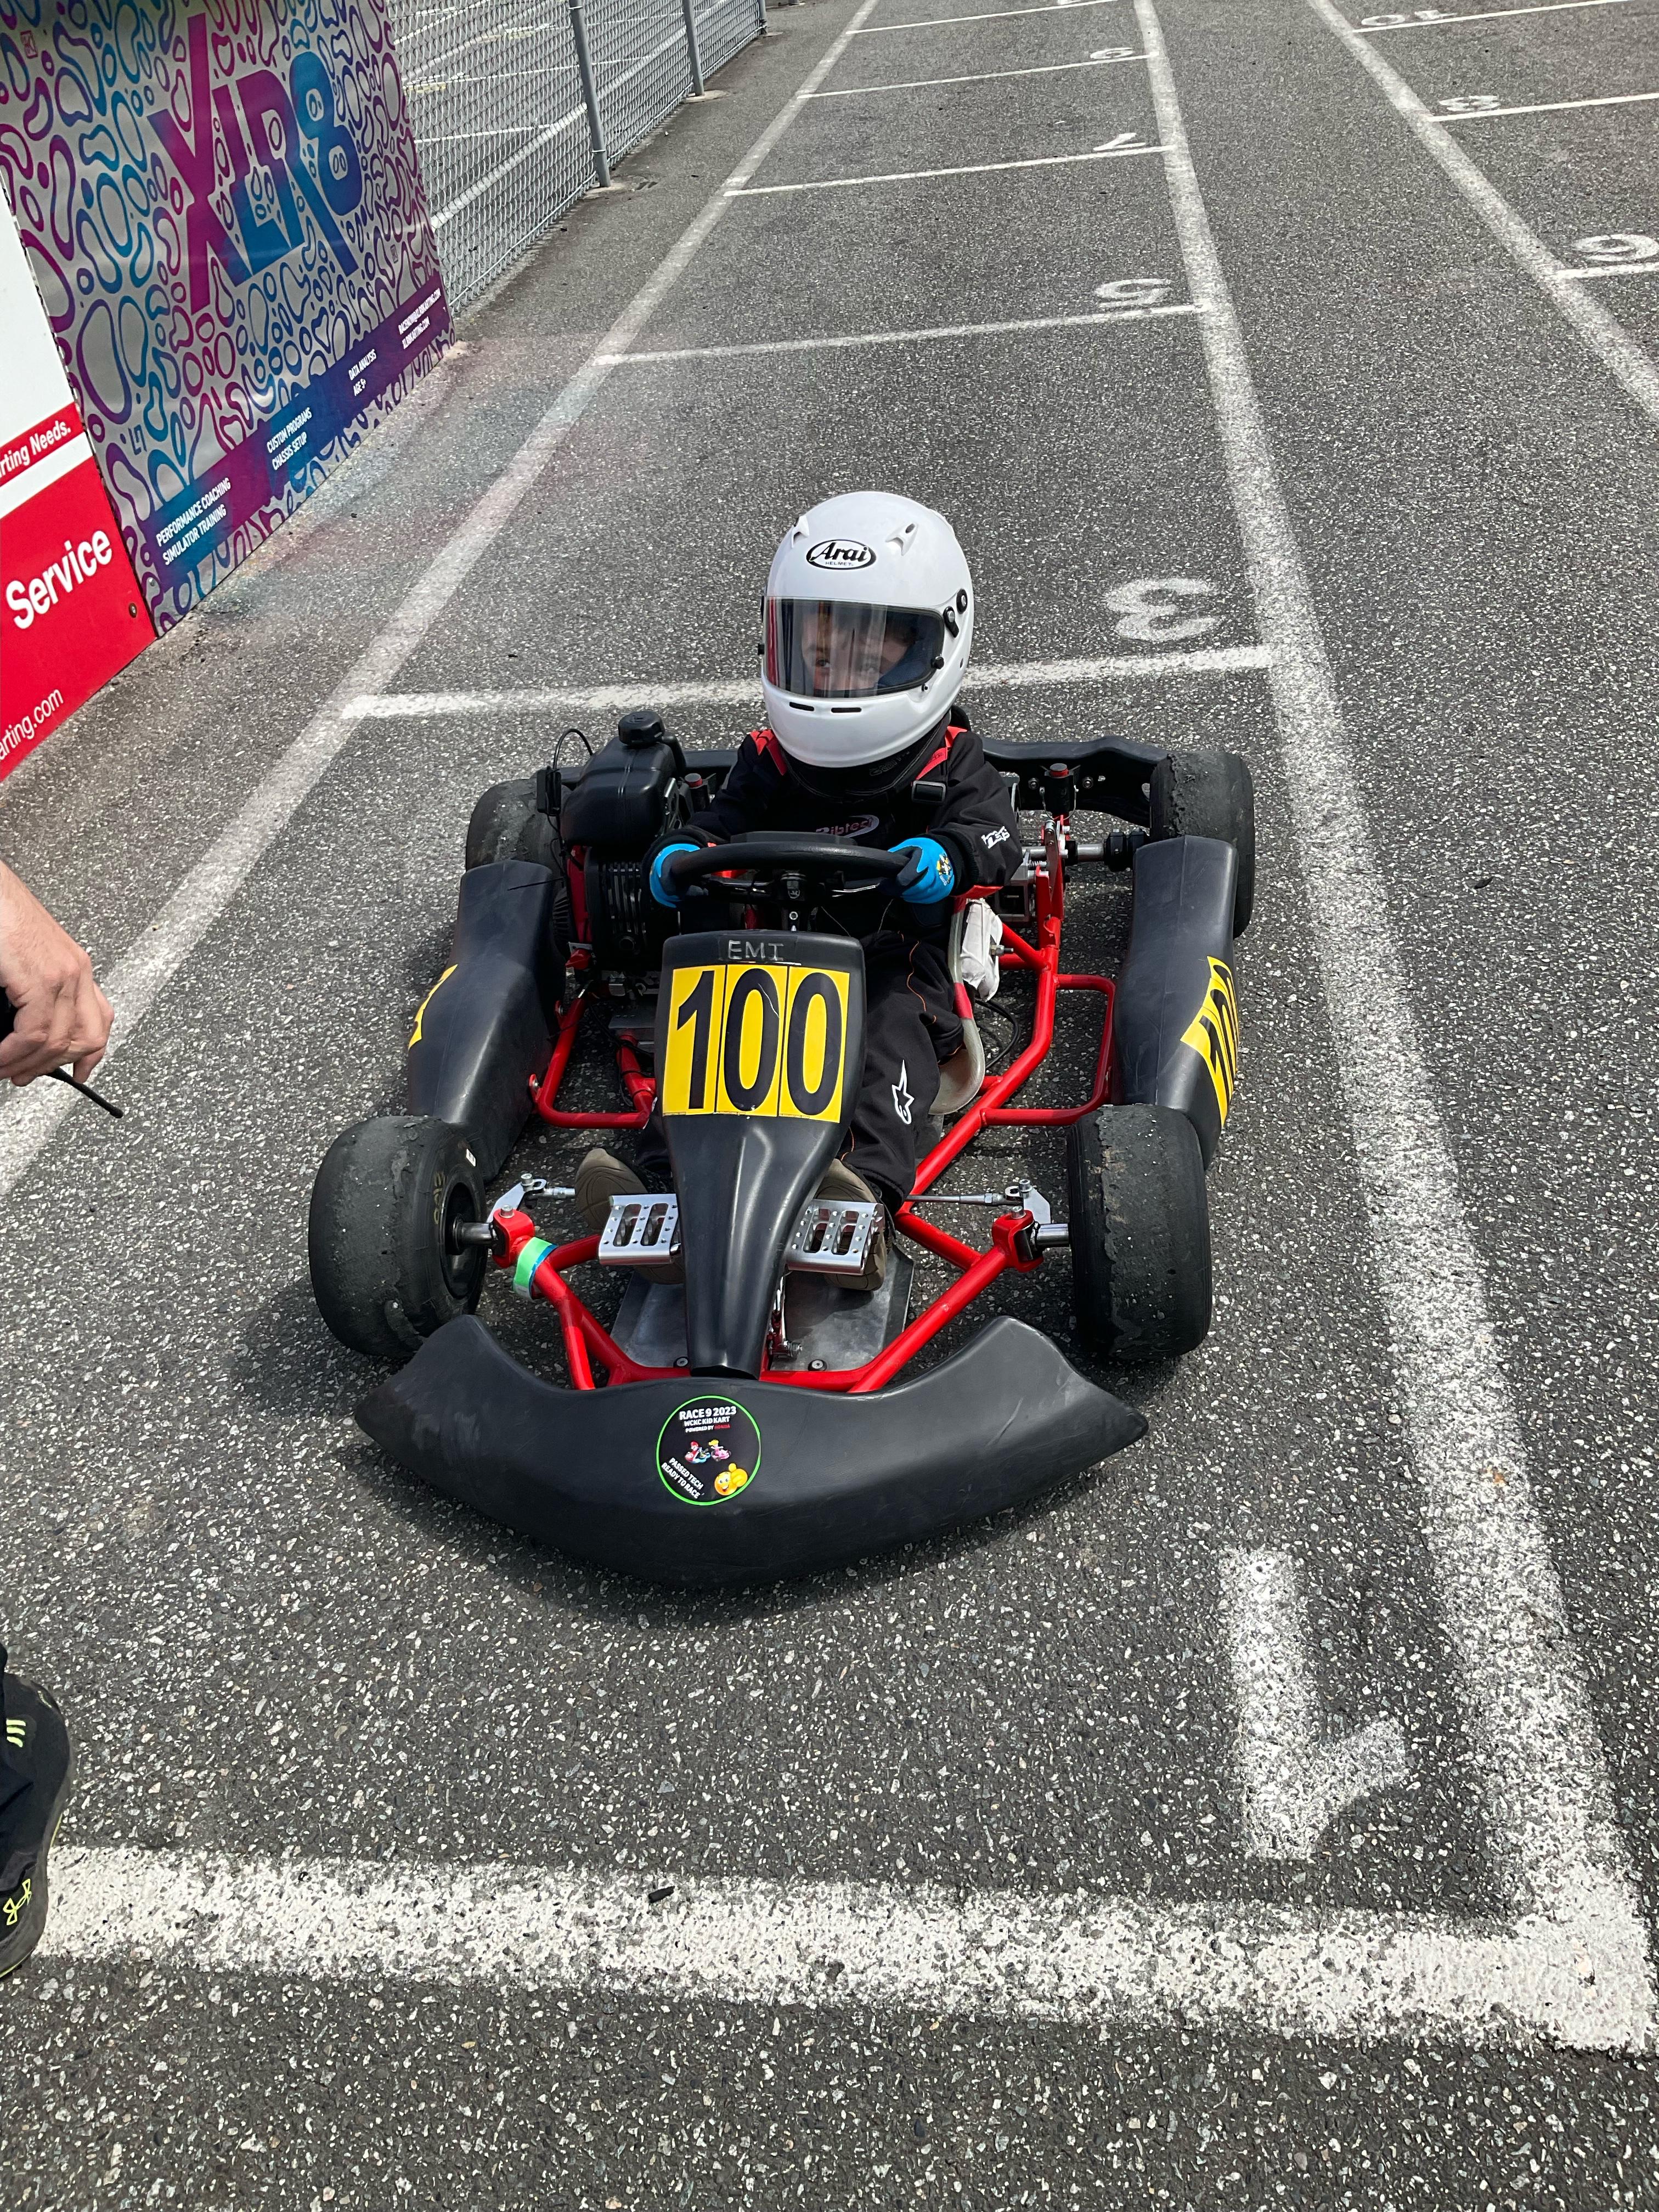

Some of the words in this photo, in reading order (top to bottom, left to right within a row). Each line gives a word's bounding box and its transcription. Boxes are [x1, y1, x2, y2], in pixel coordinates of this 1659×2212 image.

[1093, 132, 1146, 151] 7
[147, 13, 362, 315] XLR8
[1094, 278, 1172, 308] 5
[348, 364, 360, 381] DATA
[359, 349, 376, 371] ANALYSIS
[353, 381, 362, 396] AGE
[0, 445, 30, 478] rting
[29, 420, 71, 455] Needs.
[267, 427, 288, 453] CUSTOM
[286, 407, 312, 437] PROGRAMS
[272, 444, 294, 470] CHASSIS
[292, 431, 307, 453] SETUP
[156, 500, 203, 547] PERFORMANCE
[201, 477, 231, 510] COACHING
[162, 527, 200, 565] SIMULATOR
[198, 504, 227, 535] TRAINING
[810, 542, 868, 562] Arai
[5, 530, 112, 629] Service
[1105, 578, 1216, 642] 3
[676, 968, 843, 1116] 100
[679, 1408, 705, 1420] RACE
[705, 1408, 712, 1417] 9
[713, 1406, 737, 1417] 2023
[661, 1462, 680, 1480] READY
[678, 1476, 687, 1486] TO
[684, 1483, 701, 1499] RACE
[669, 1457, 690, 1477] PASSED
[688, 1474, 704, 1490] TECH
[1219, 1547, 1406, 1860] 1
